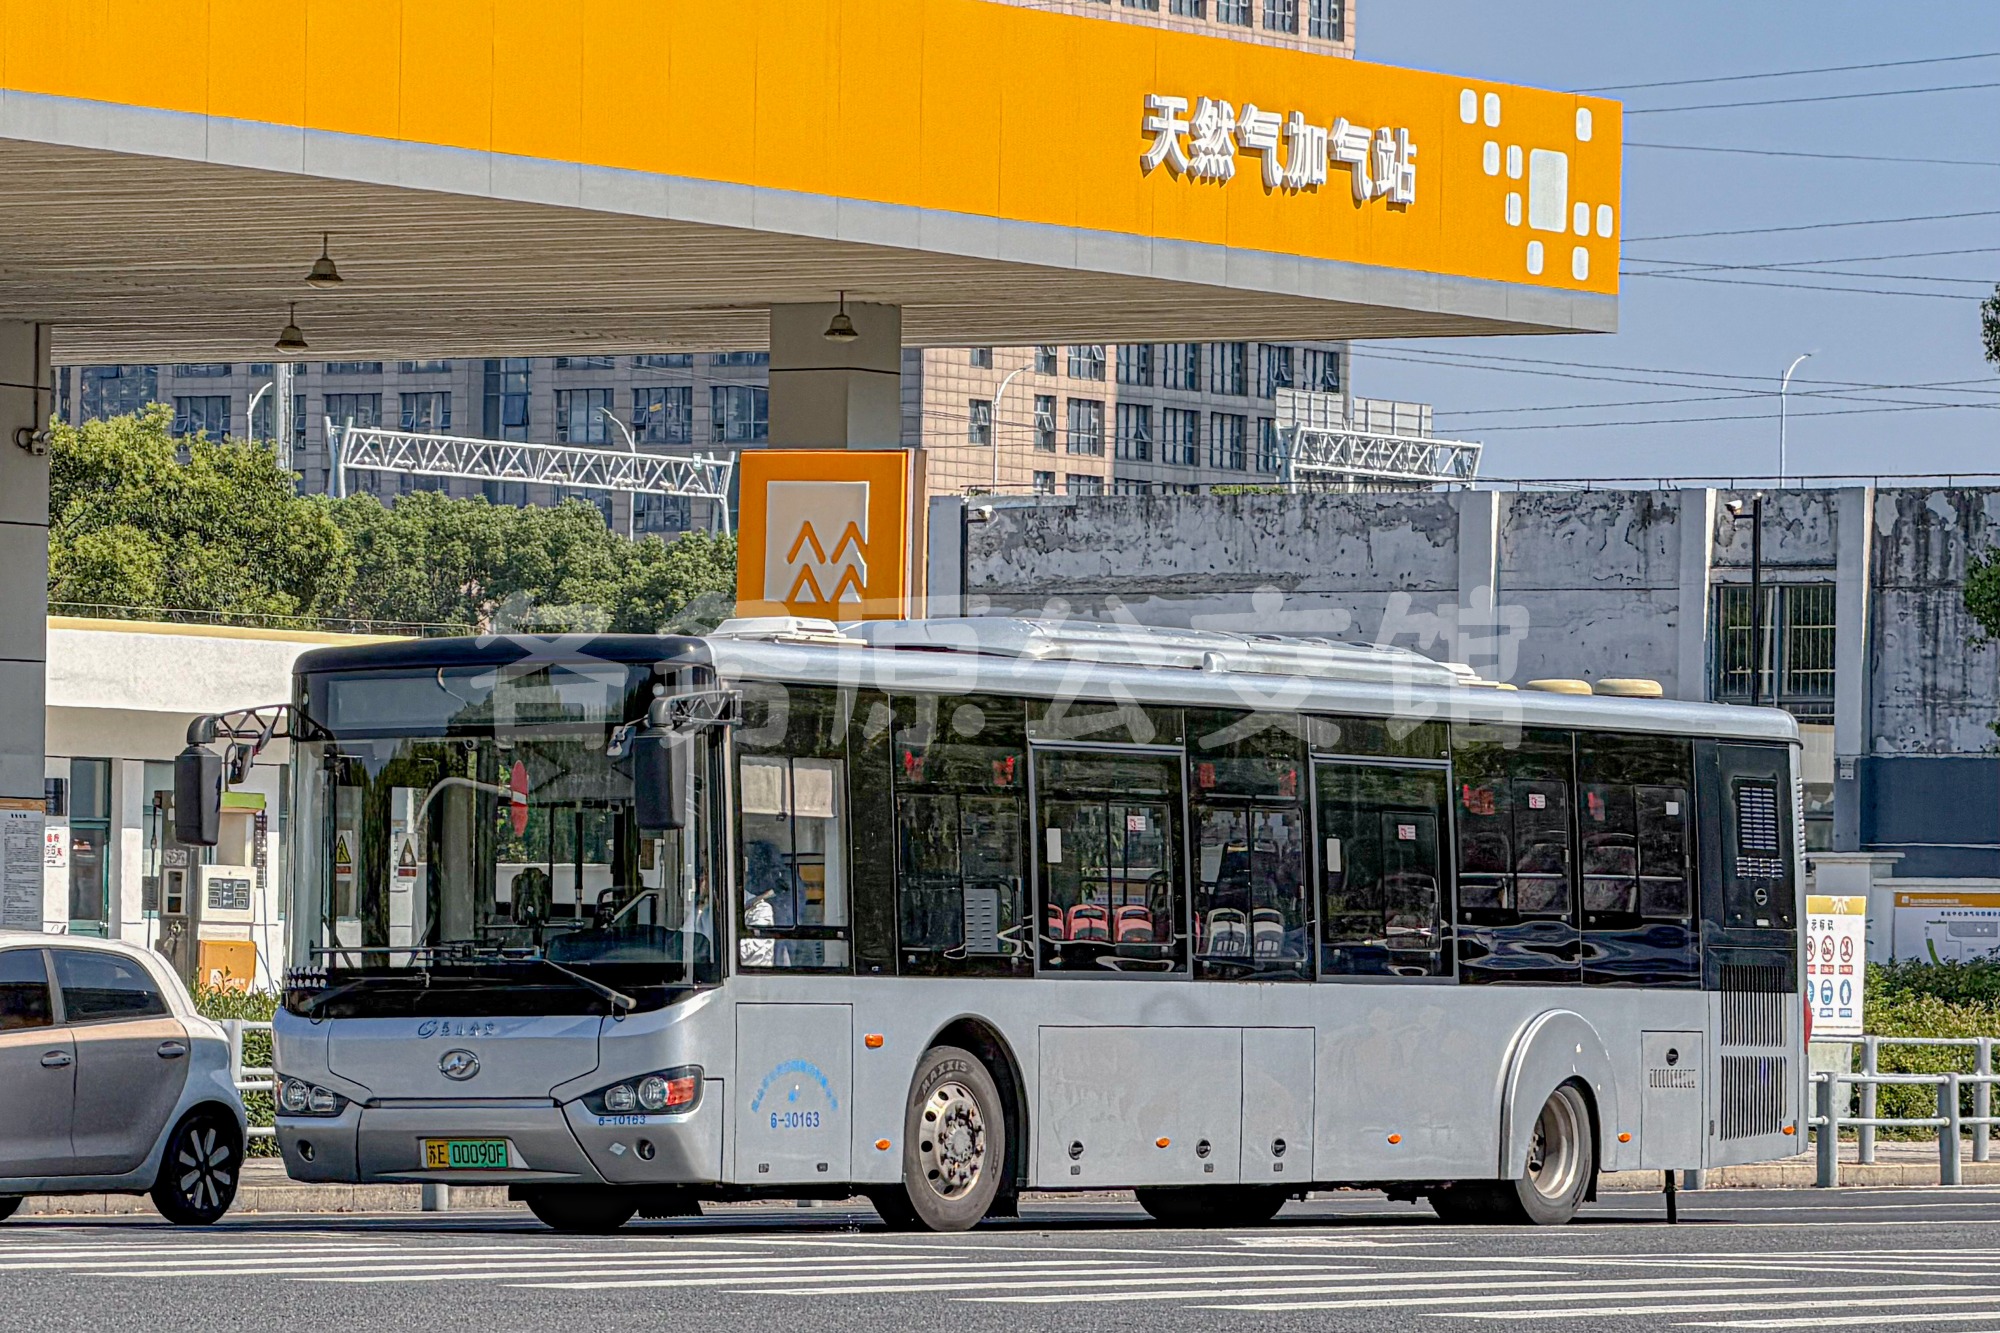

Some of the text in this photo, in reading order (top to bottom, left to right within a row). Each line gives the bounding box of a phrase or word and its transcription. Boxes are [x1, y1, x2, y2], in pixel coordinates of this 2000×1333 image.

[1141, 93, 1416, 205] 天然气加气站
[921, 1060, 968, 1095] MAXXIS
[770, 1111, 820, 1129] 6-30163
